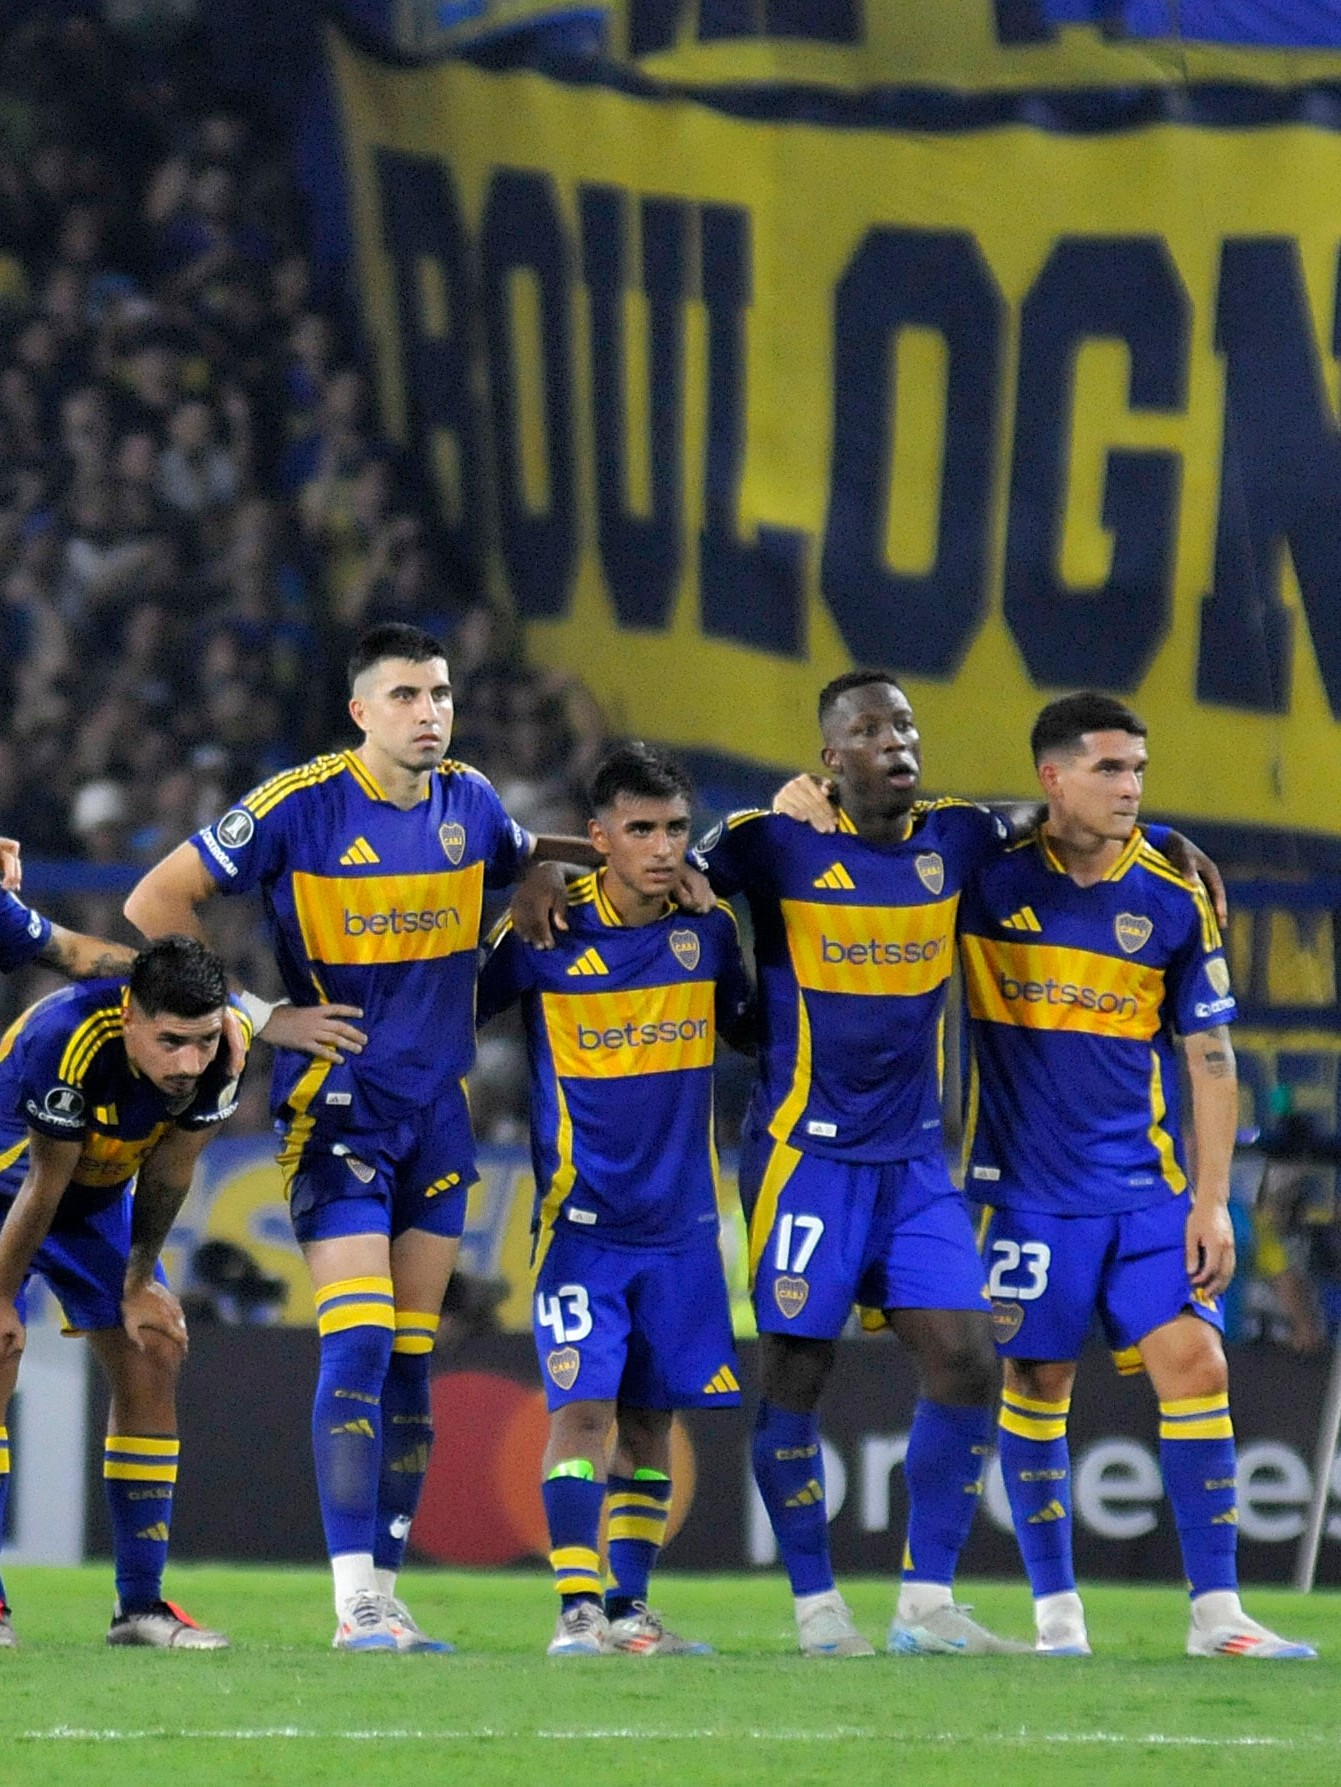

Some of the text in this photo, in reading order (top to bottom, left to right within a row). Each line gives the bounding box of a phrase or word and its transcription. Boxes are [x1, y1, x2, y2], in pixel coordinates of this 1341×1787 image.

[344, 907, 461, 936] betsson
[999, 972, 1139, 1018] betsson
[775, 1213, 825, 1273] 17
[778, 1290, 803, 1300] CABJ
[989, 1240, 1051, 1300] 23
[538, 1285, 593, 1344] 43
